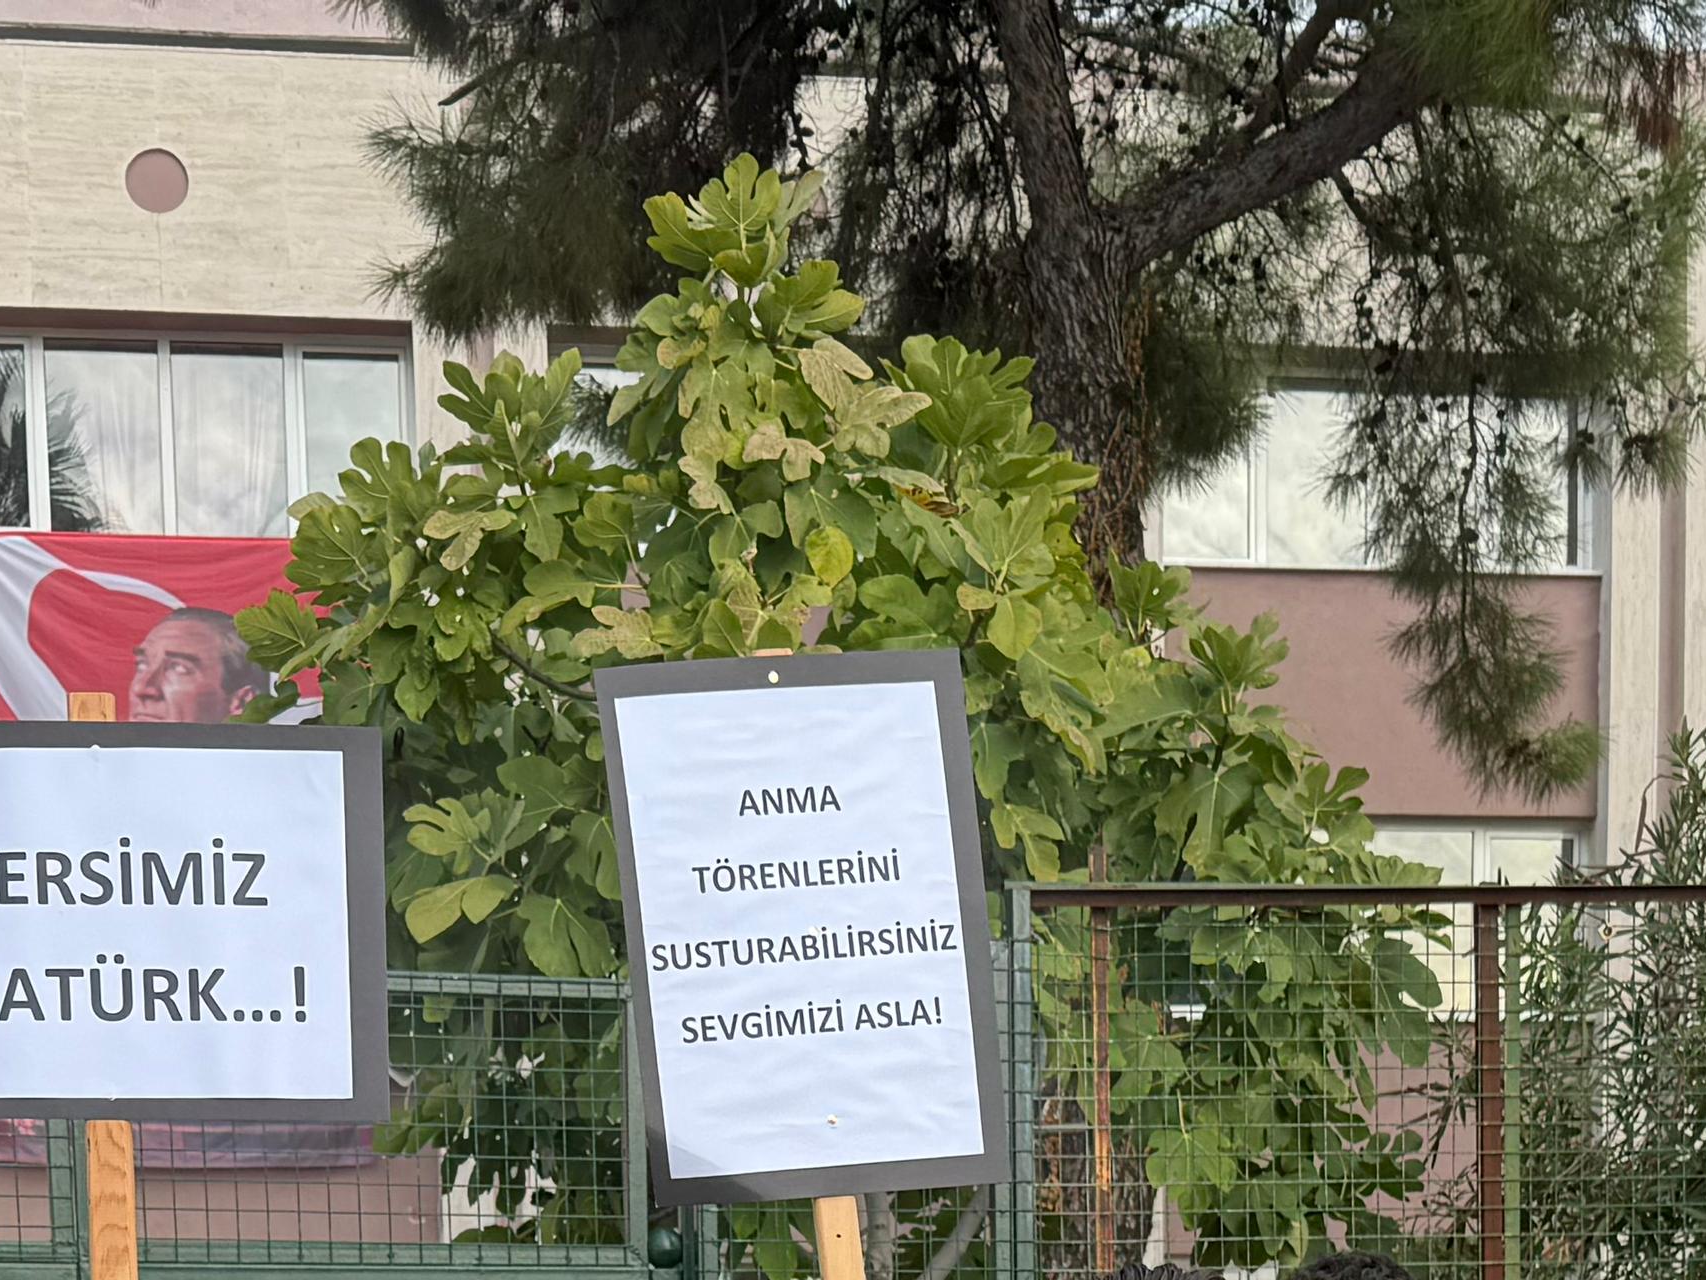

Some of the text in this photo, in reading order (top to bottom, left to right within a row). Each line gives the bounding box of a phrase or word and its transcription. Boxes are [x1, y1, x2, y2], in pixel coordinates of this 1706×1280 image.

[739, 785, 842, 817] ANMA
[691, 847, 900, 894] TÖRENLERİNİ
[651, 918, 958, 972] SUSTURABİLİRSİNİZ
[681, 996, 942, 1044] SEVGİMİZİ ASLA!
